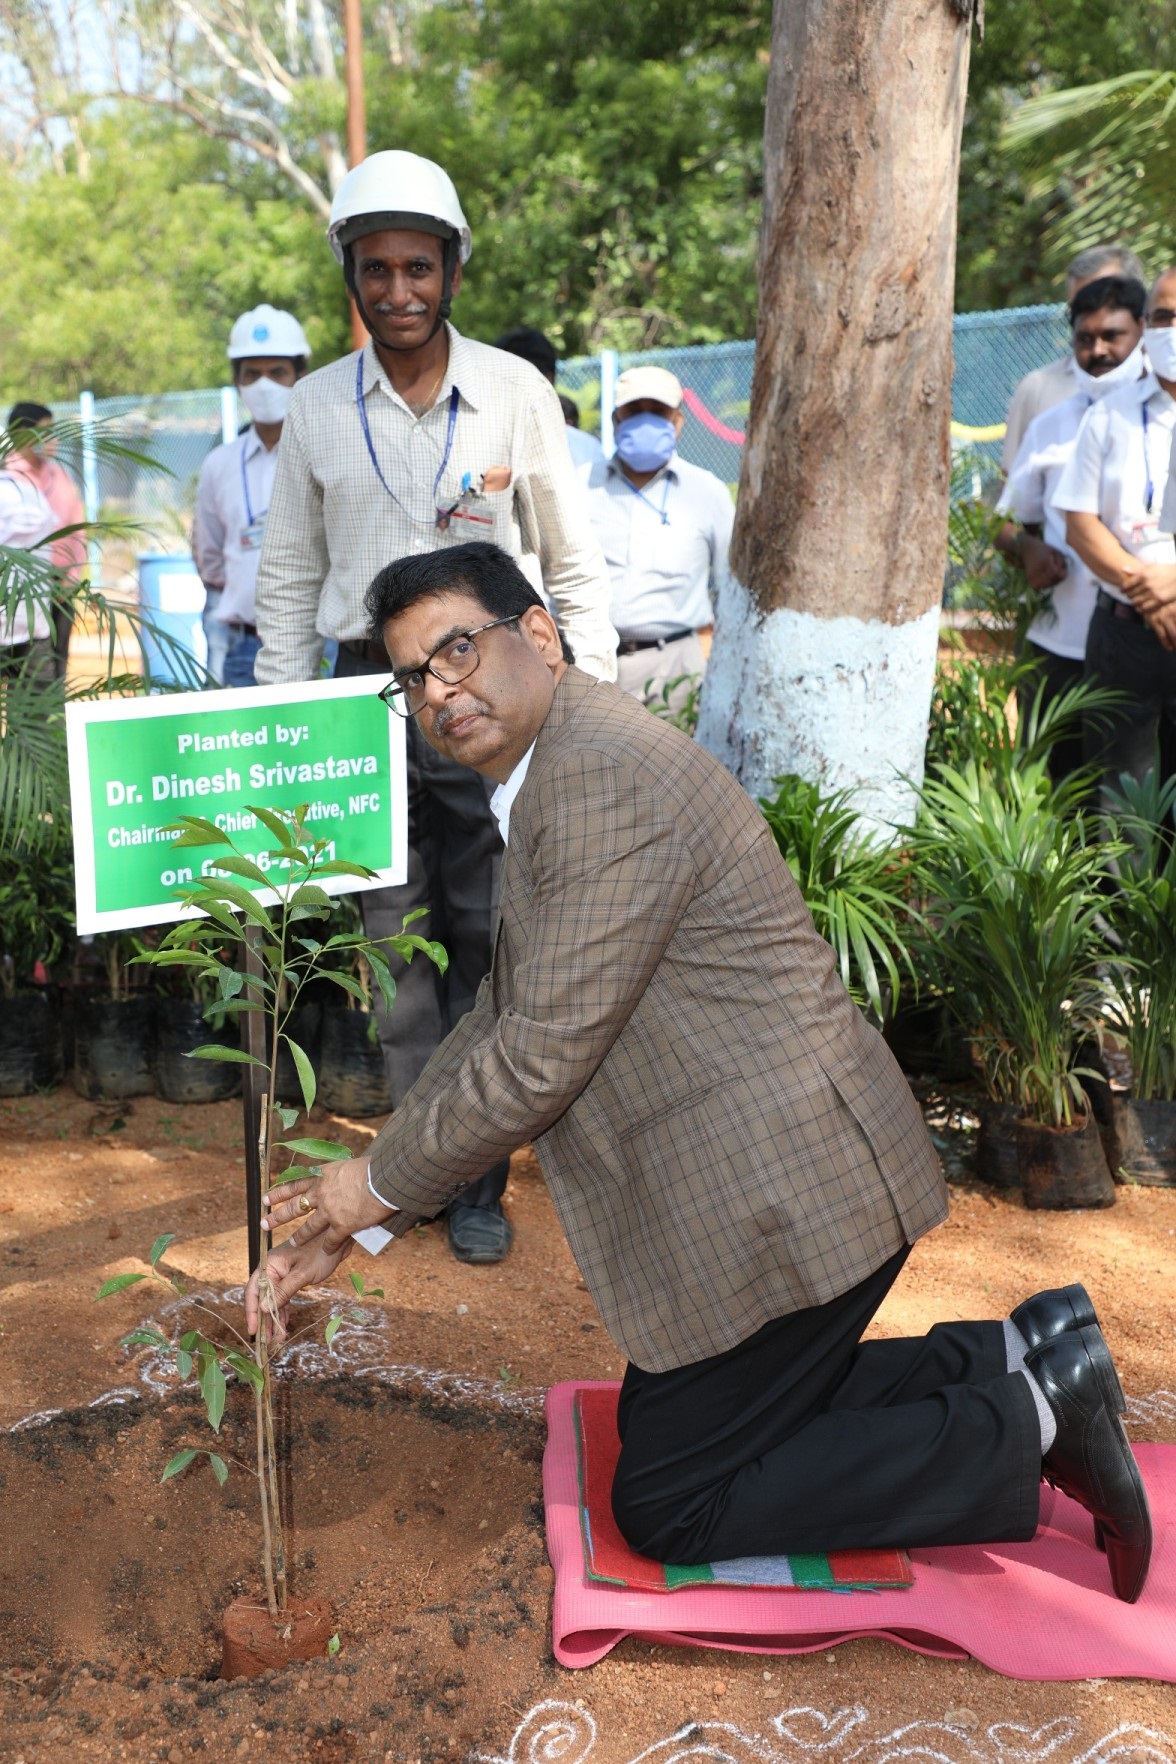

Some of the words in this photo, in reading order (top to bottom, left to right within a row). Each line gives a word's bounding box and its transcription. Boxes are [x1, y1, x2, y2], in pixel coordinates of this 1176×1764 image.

[178, 726, 268, 754] Planted
[275, 724, 309, 746] by:
[106, 781, 143, 807] Dr.
[152, 768, 241, 801] Dinesh
[249, 755, 378, 789] Srivastava
[107, 818, 194, 848] Chairma
[348, 793, 380, 815] NFC
[160, 867, 193, 887] on
